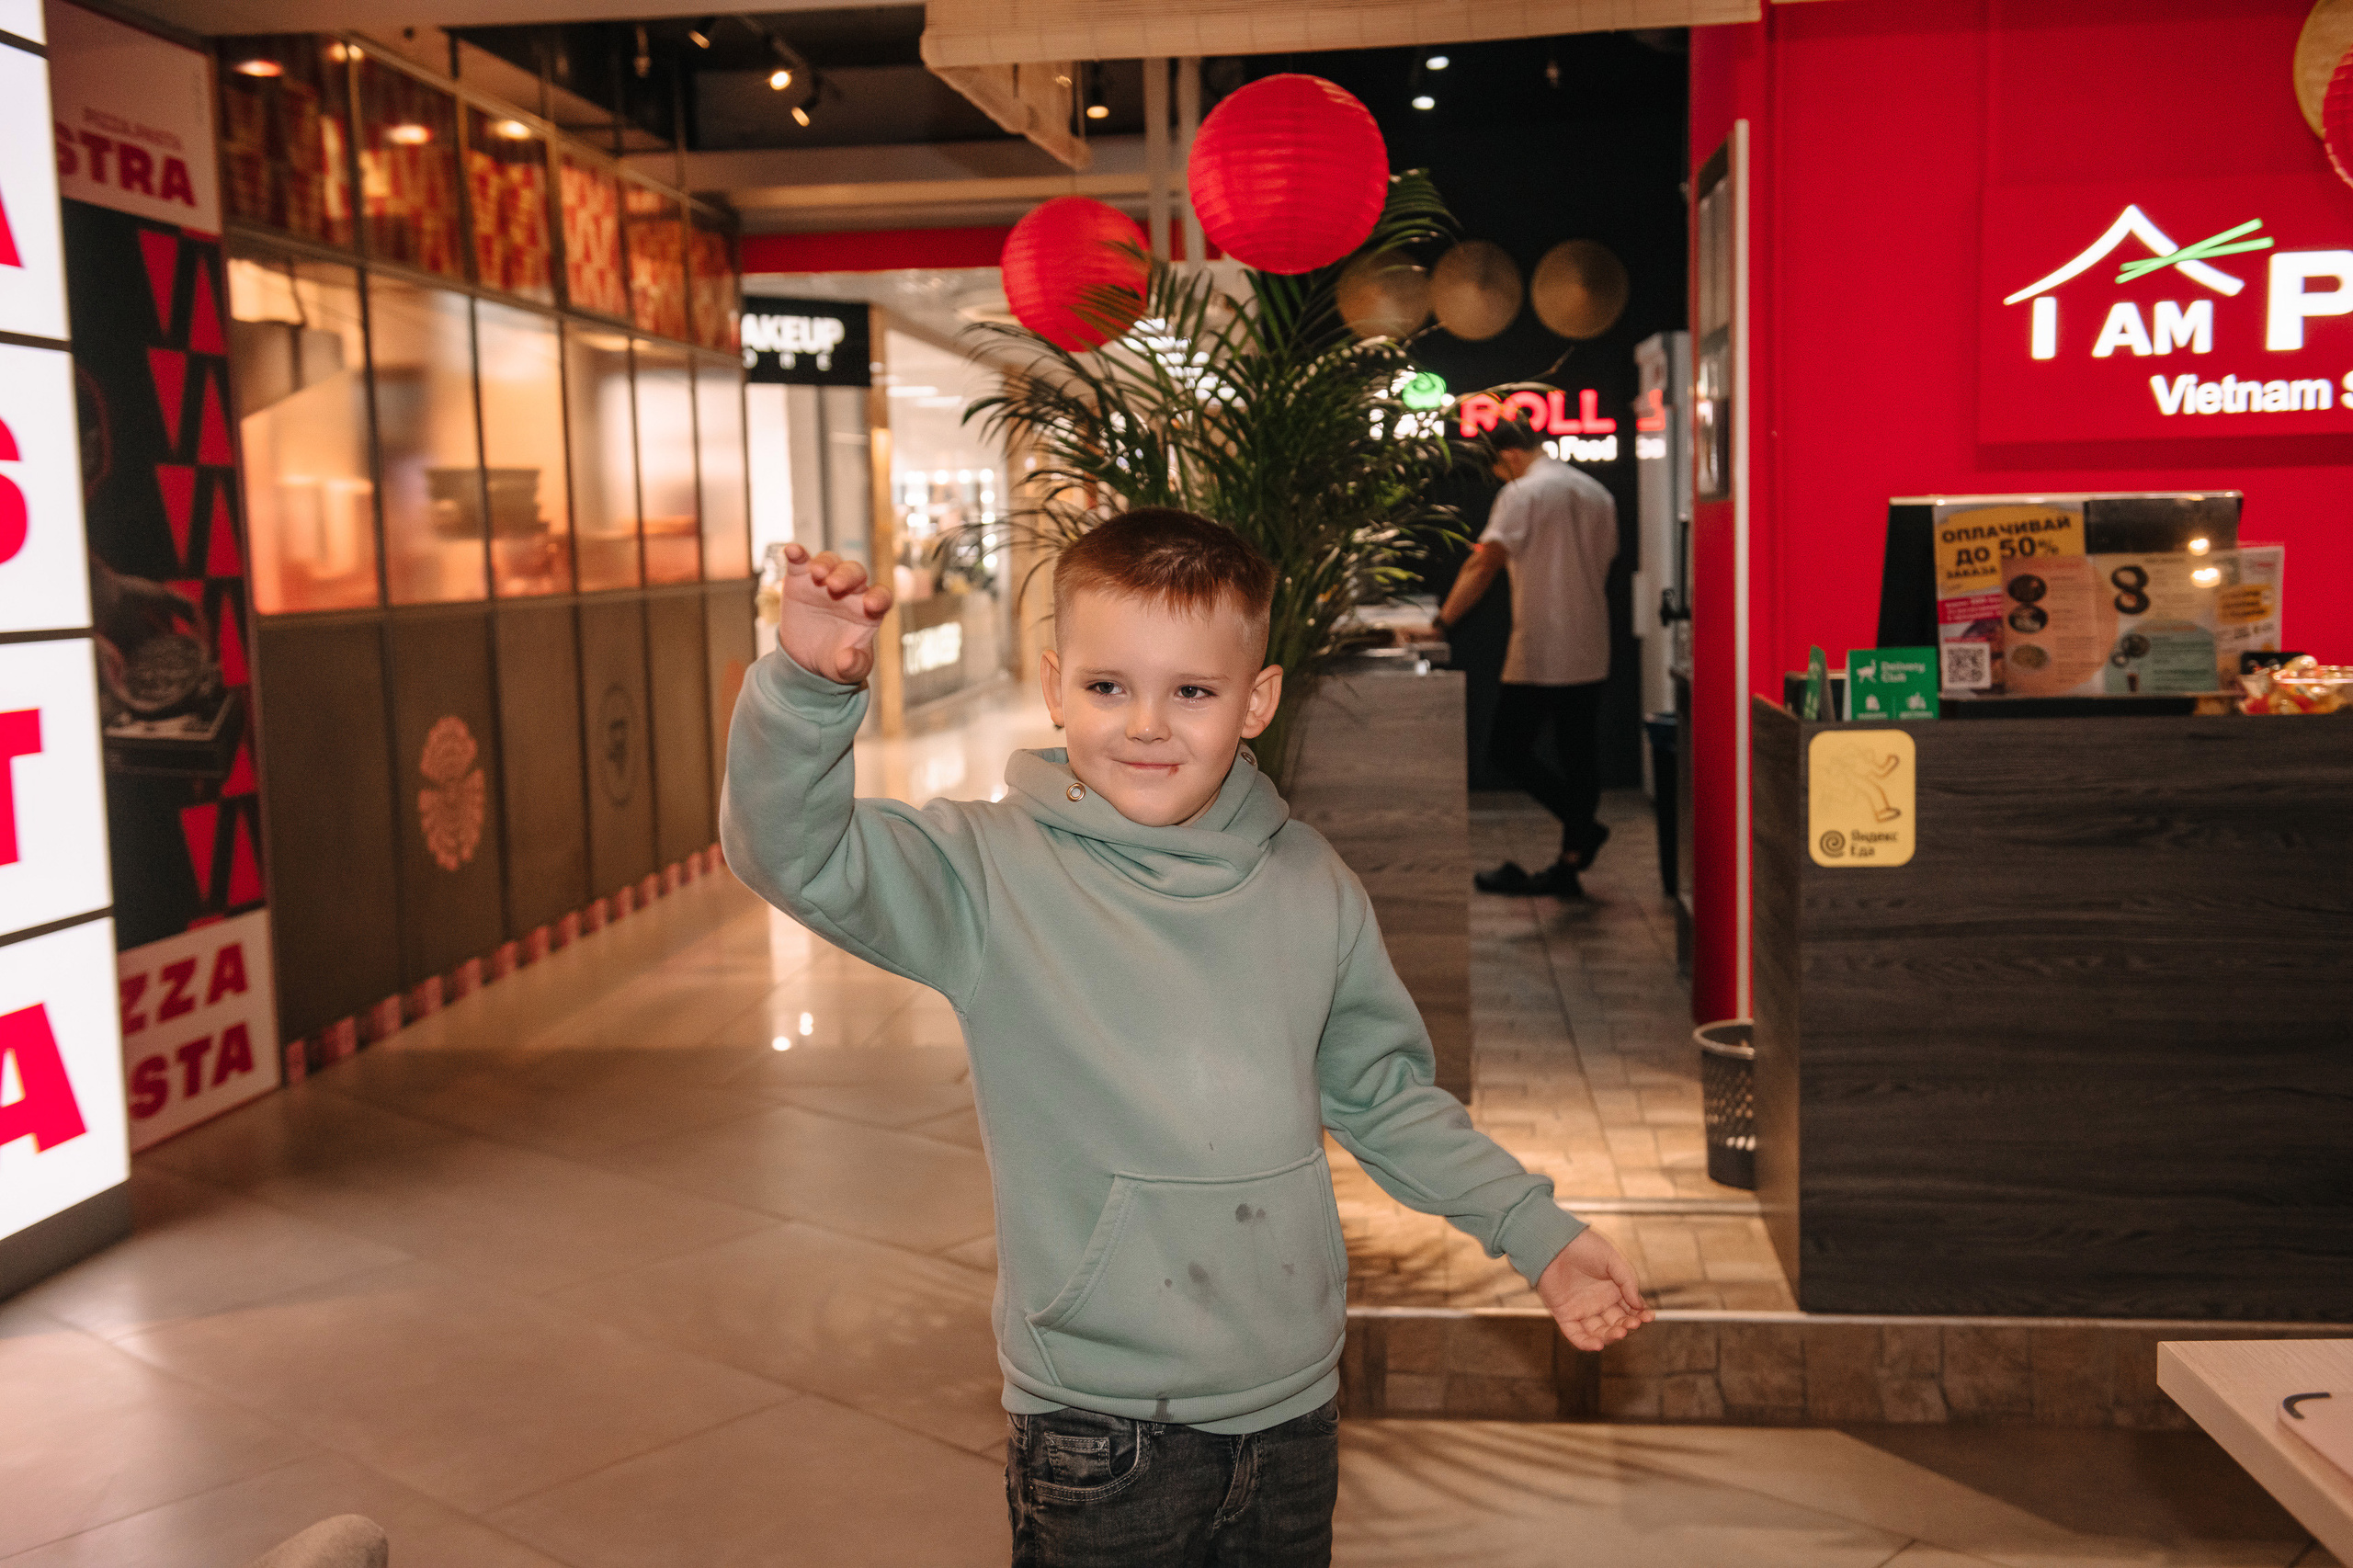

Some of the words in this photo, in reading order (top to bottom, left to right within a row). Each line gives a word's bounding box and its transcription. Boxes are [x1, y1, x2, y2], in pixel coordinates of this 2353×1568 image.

[2031, 296, 2057, 360] I
[2092, 299, 2214, 358] AM
[2265, 249, 2353, 351] P
[1460, 389, 1618, 437] ROLL
[2150, 374, 2333, 415] Vietnam
[1941, 515, 2071, 544] ОПЛАЧИВАЙ
[1956, 546, 1990, 567] ДО
[129, 1021, 254, 1119] STA
